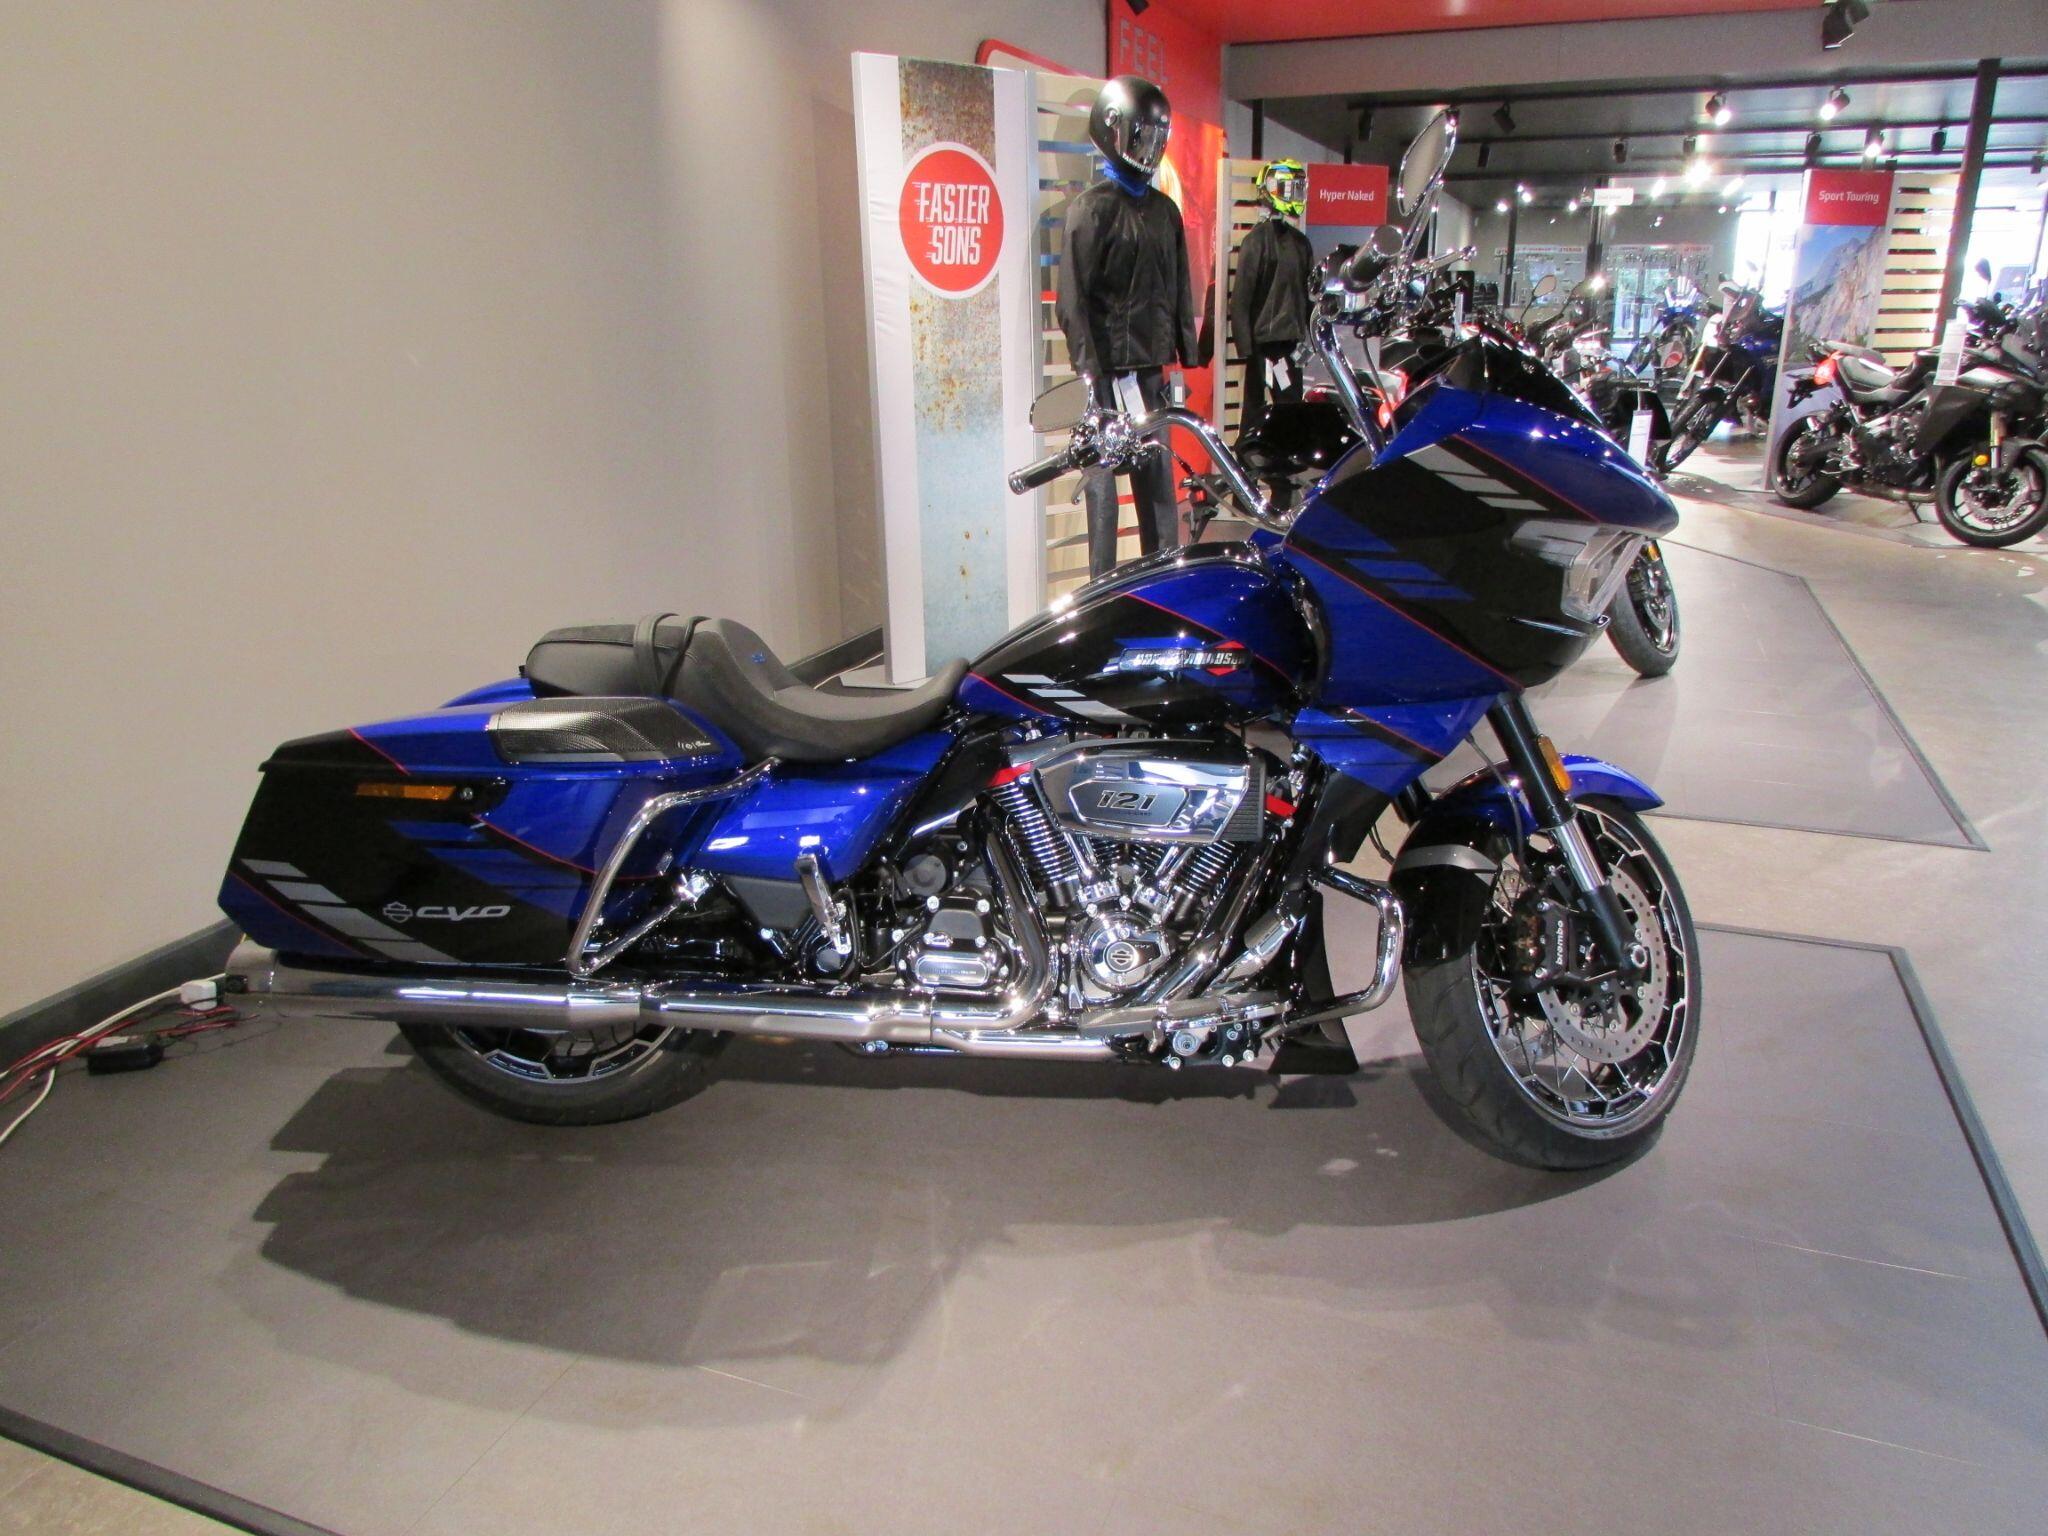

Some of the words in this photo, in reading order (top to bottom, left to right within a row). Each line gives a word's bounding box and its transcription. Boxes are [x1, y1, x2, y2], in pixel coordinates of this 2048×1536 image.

[914, 181, 990, 224] FASTER
[1319, 188, 1346, 202] Hyper
[1347, 190, 1375, 201] Naked
[1818, 190, 1844, 203] Sport
[1846, 191, 1879, 205] Touring
[928, 225, 981, 265] SONS
[1097, 789, 1158, 811] 121
[416, 905, 511, 921] CVO
[1555, 920, 1564, 965] brembo
